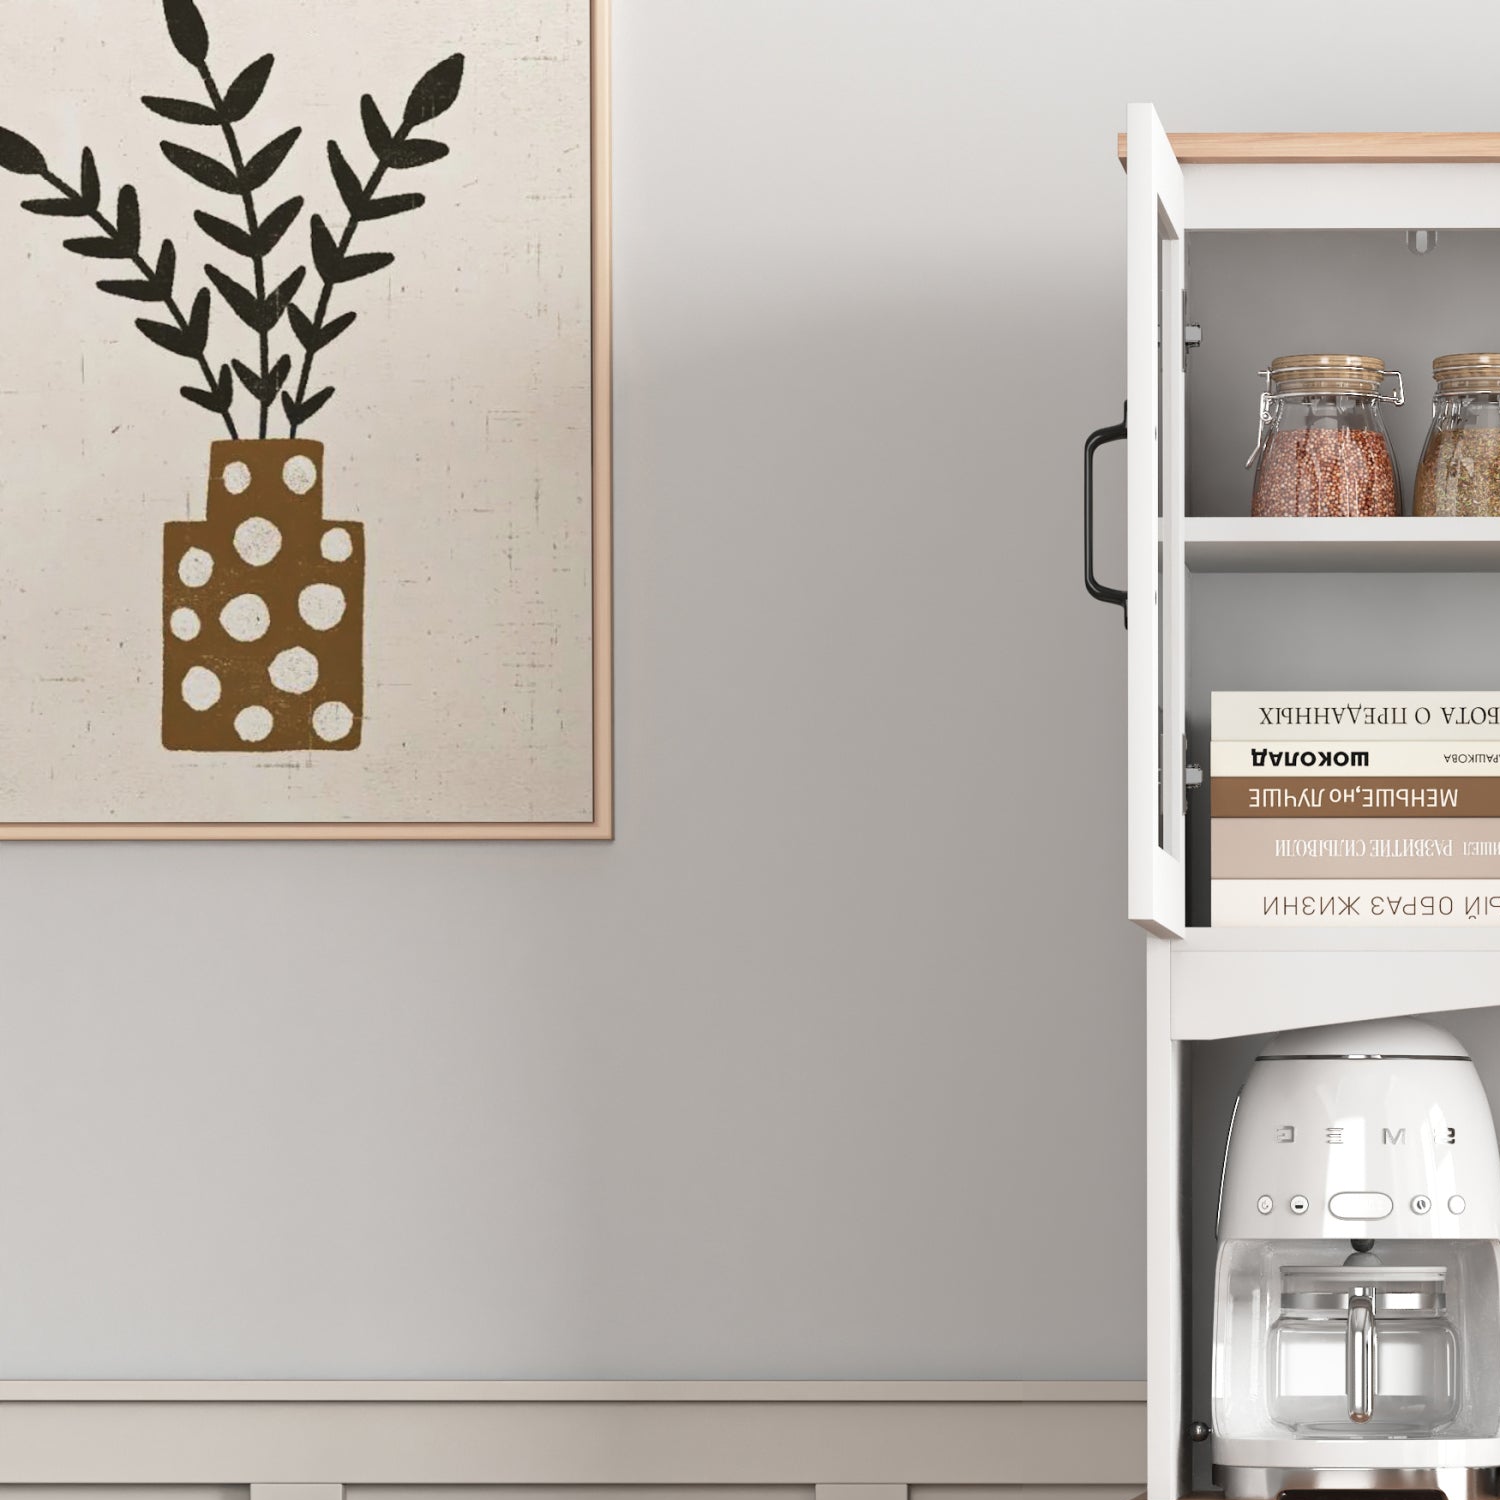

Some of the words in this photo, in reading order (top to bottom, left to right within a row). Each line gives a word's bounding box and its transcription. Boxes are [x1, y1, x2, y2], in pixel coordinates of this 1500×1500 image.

[1259, 704, 1406, 724] ПРЕДАННЫХ
[1415, 707, 1430, 724] О
[1251, 749, 1368, 766] ШОКОЛАД
[1249, 788, 1325, 807] ЛУЧШЕ
[1370, 839, 1452, 857] РАЗВИТИЕ
[1264, 896, 1360, 915] ЖИЗНИ
[1371, 896, 1452, 915] ОБРАЗ
